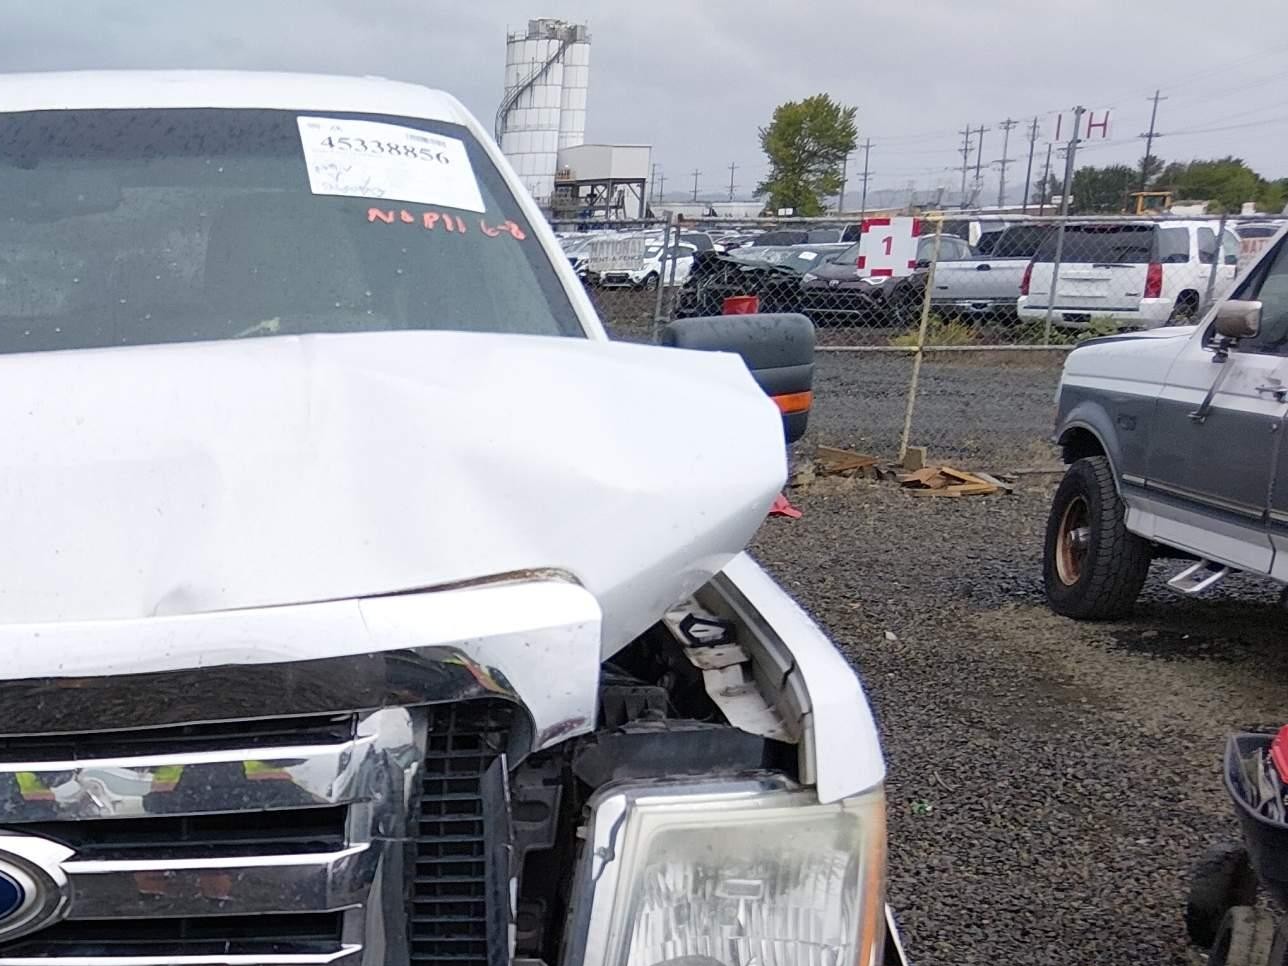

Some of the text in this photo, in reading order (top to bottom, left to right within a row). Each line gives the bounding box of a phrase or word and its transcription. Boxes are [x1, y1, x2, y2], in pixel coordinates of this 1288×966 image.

[1086, 111, 1110, 138] H
[320, 136, 450, 165] 45338856
[881, 236, 892, 256] 1
